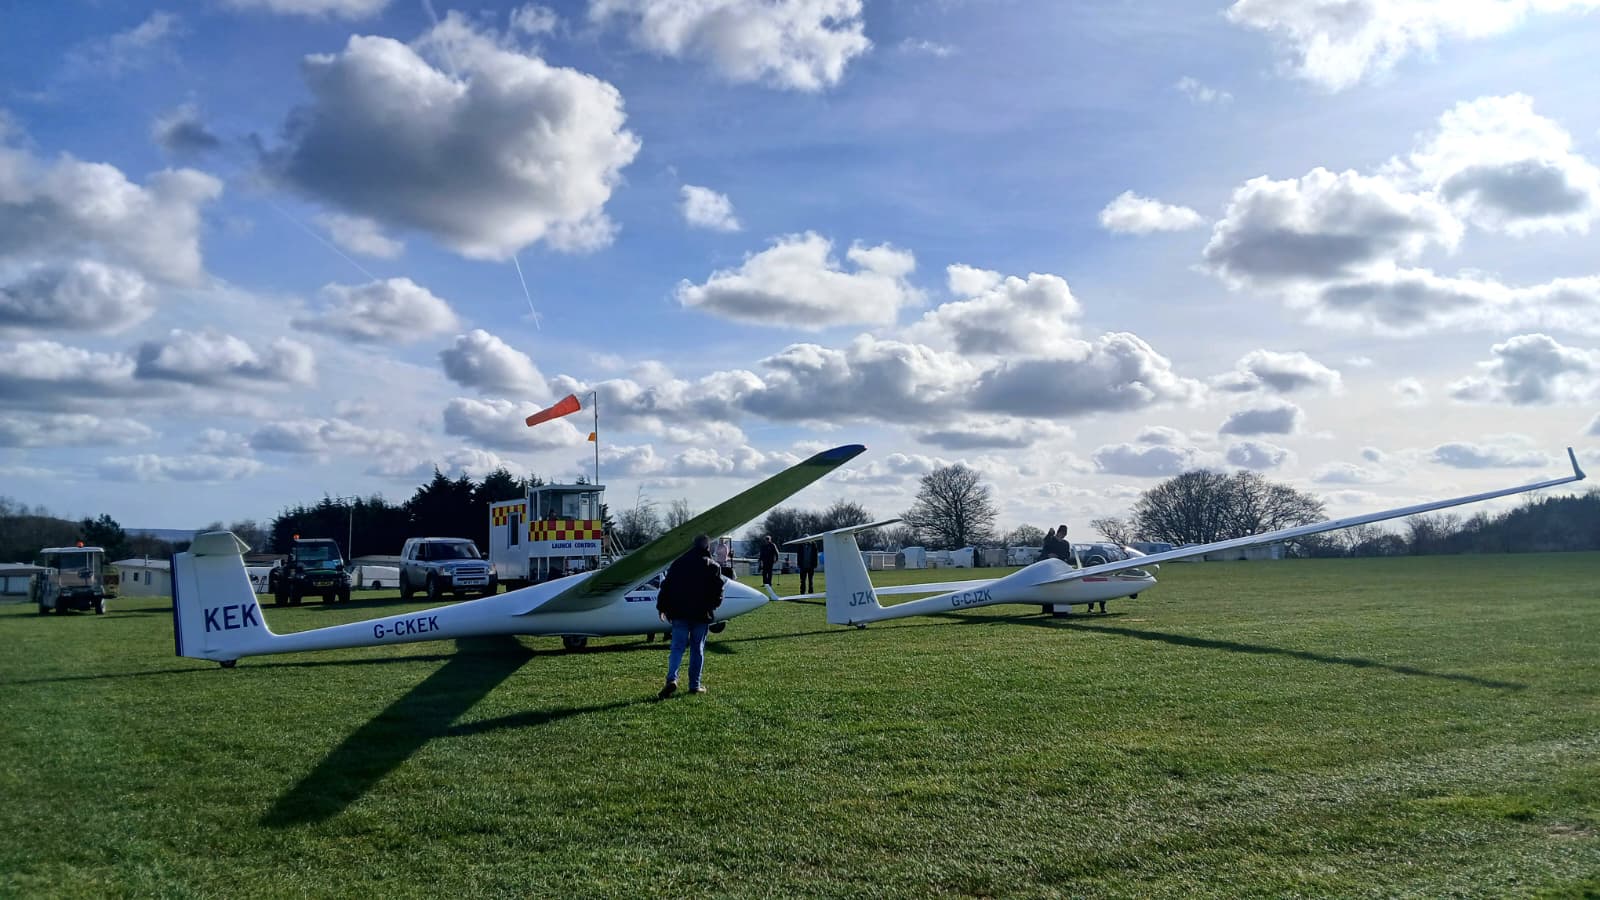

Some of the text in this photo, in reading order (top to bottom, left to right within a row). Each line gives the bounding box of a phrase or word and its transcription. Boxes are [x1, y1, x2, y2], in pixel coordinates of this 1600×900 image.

[849, 590, 875, 606] JZK
[951, 589, 992, 606] G-CJZK
[204, 603, 258, 632] KEK
[374, 615, 439, 639] G-CKEK
